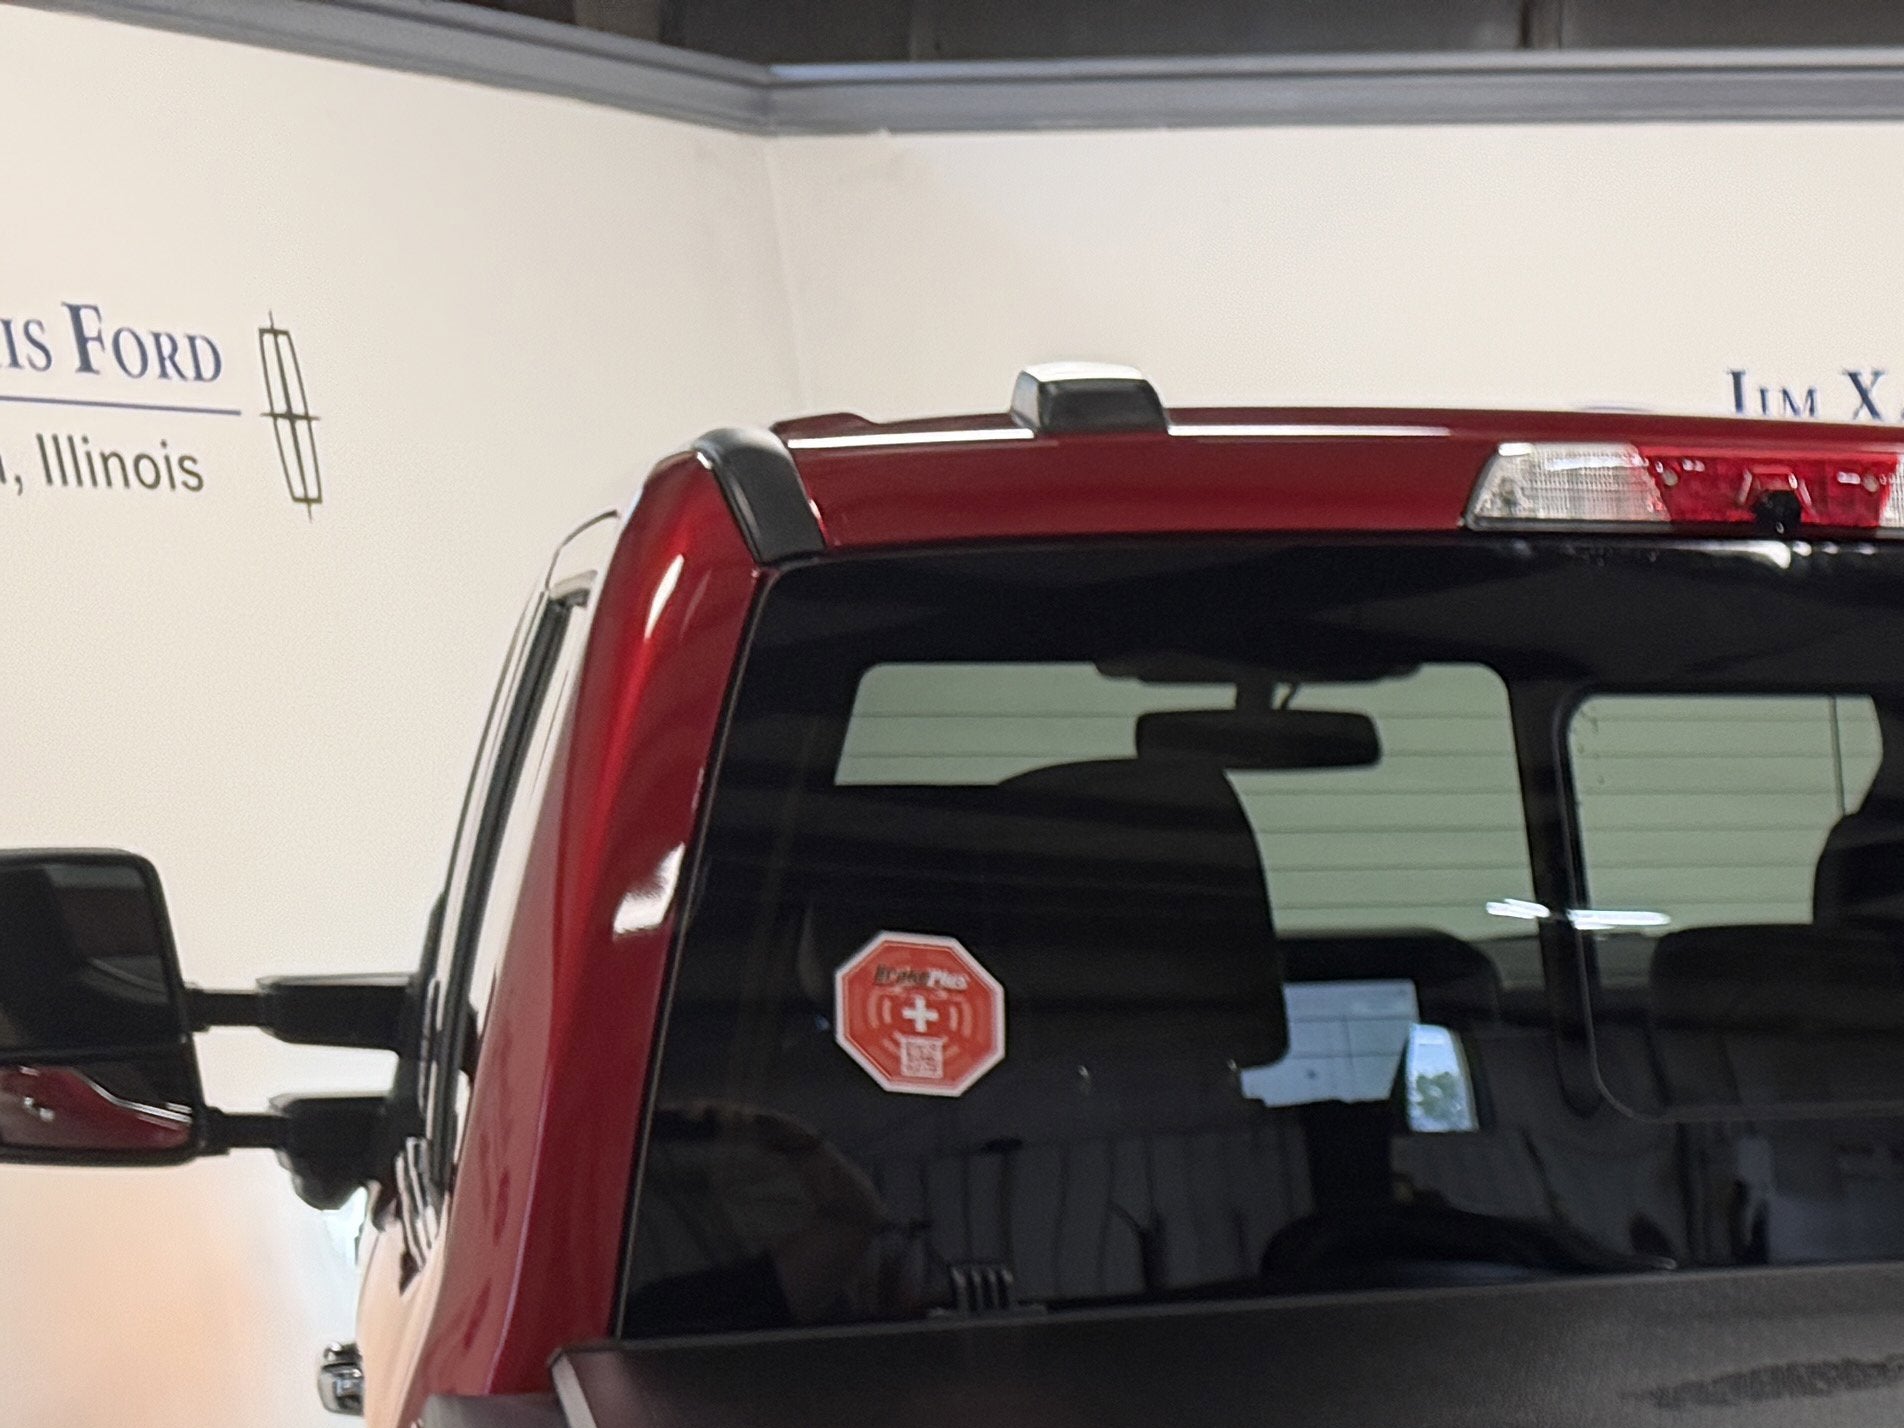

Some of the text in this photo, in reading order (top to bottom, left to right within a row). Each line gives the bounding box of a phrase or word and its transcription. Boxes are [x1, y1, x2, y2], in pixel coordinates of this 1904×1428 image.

[0, 301, 222, 382] IS FORD
[1726, 369, 1817, 416] JIM
[36, 433, 203, 491] Illinois
